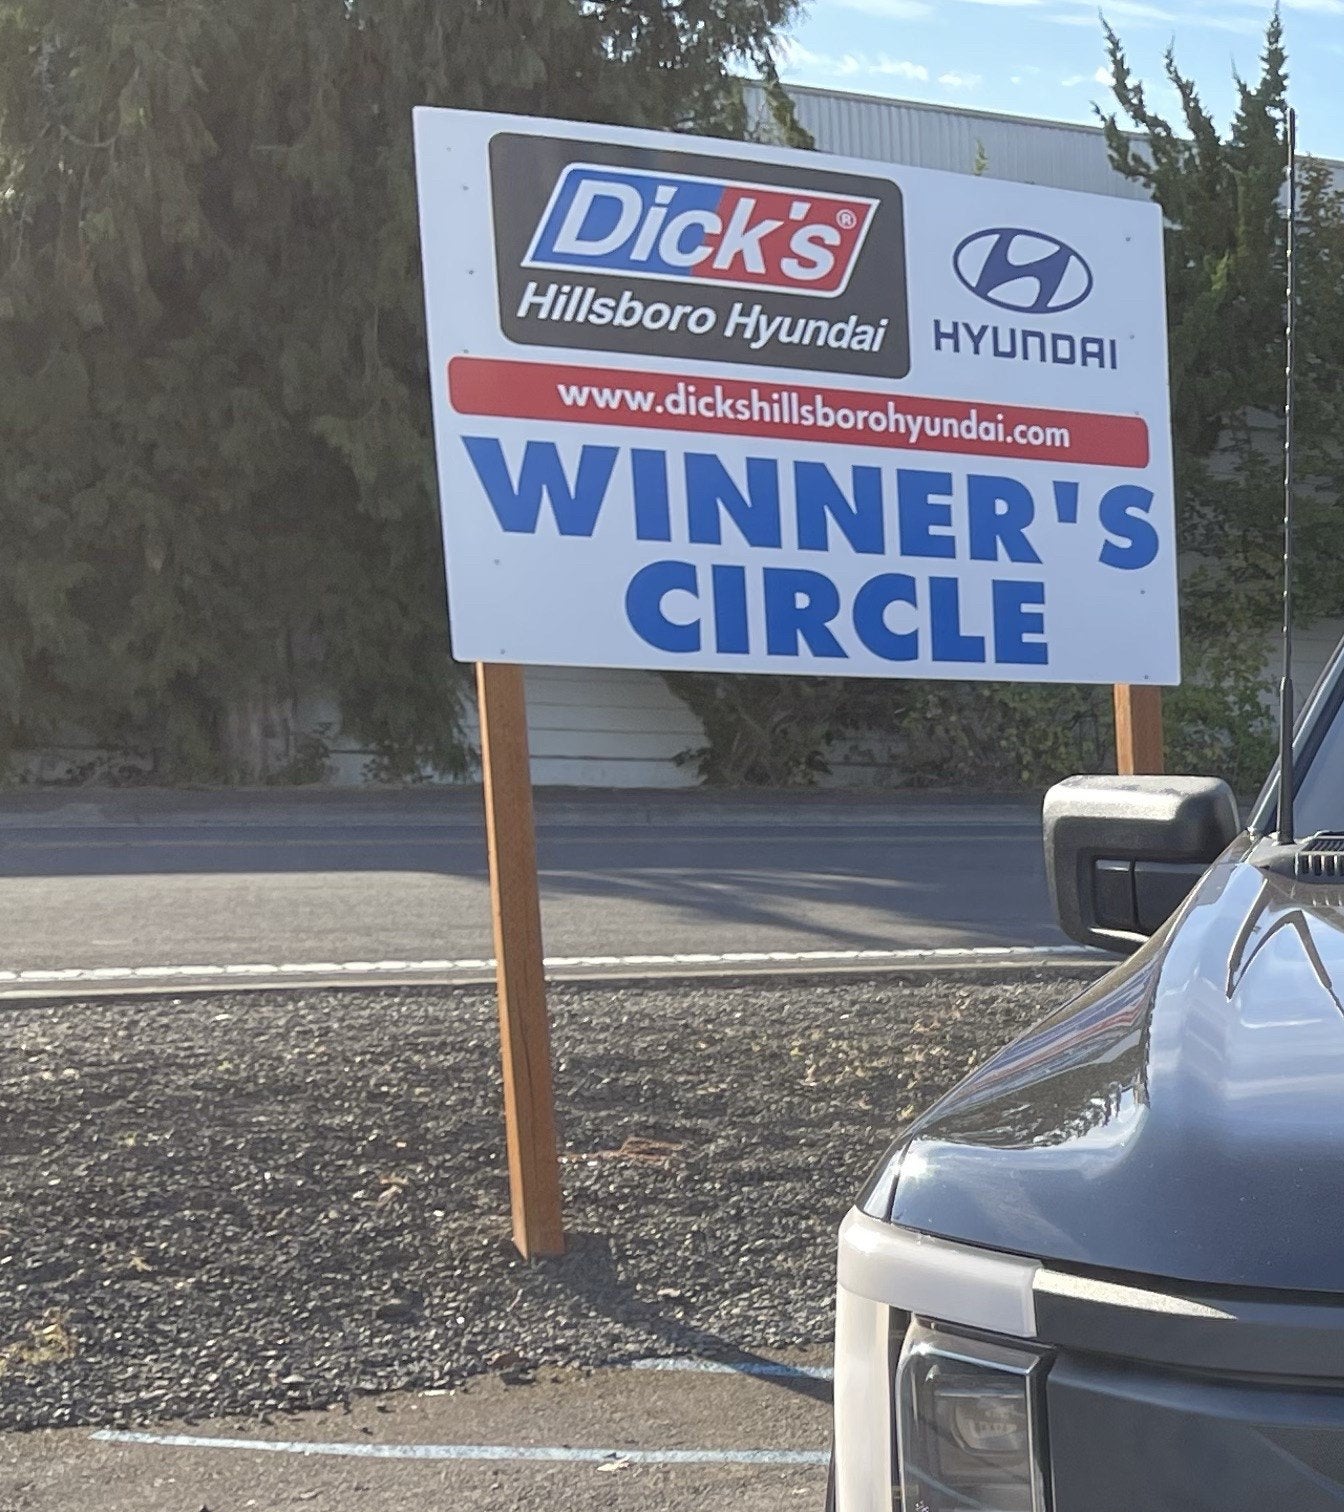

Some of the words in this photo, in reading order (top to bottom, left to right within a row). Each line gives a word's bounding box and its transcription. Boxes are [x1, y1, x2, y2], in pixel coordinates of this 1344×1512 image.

[516, 280, 717, 335] Hillsboro
[723, 302, 890, 353] Hyundai
[933, 318, 1119, 371] HYUNDAI
[557, 380, 1071, 448] www.dickshillsborohyundai.com
[461, 435, 1161, 570] WINNER'S
[624, 560, 1050, 666] CIRCLE
